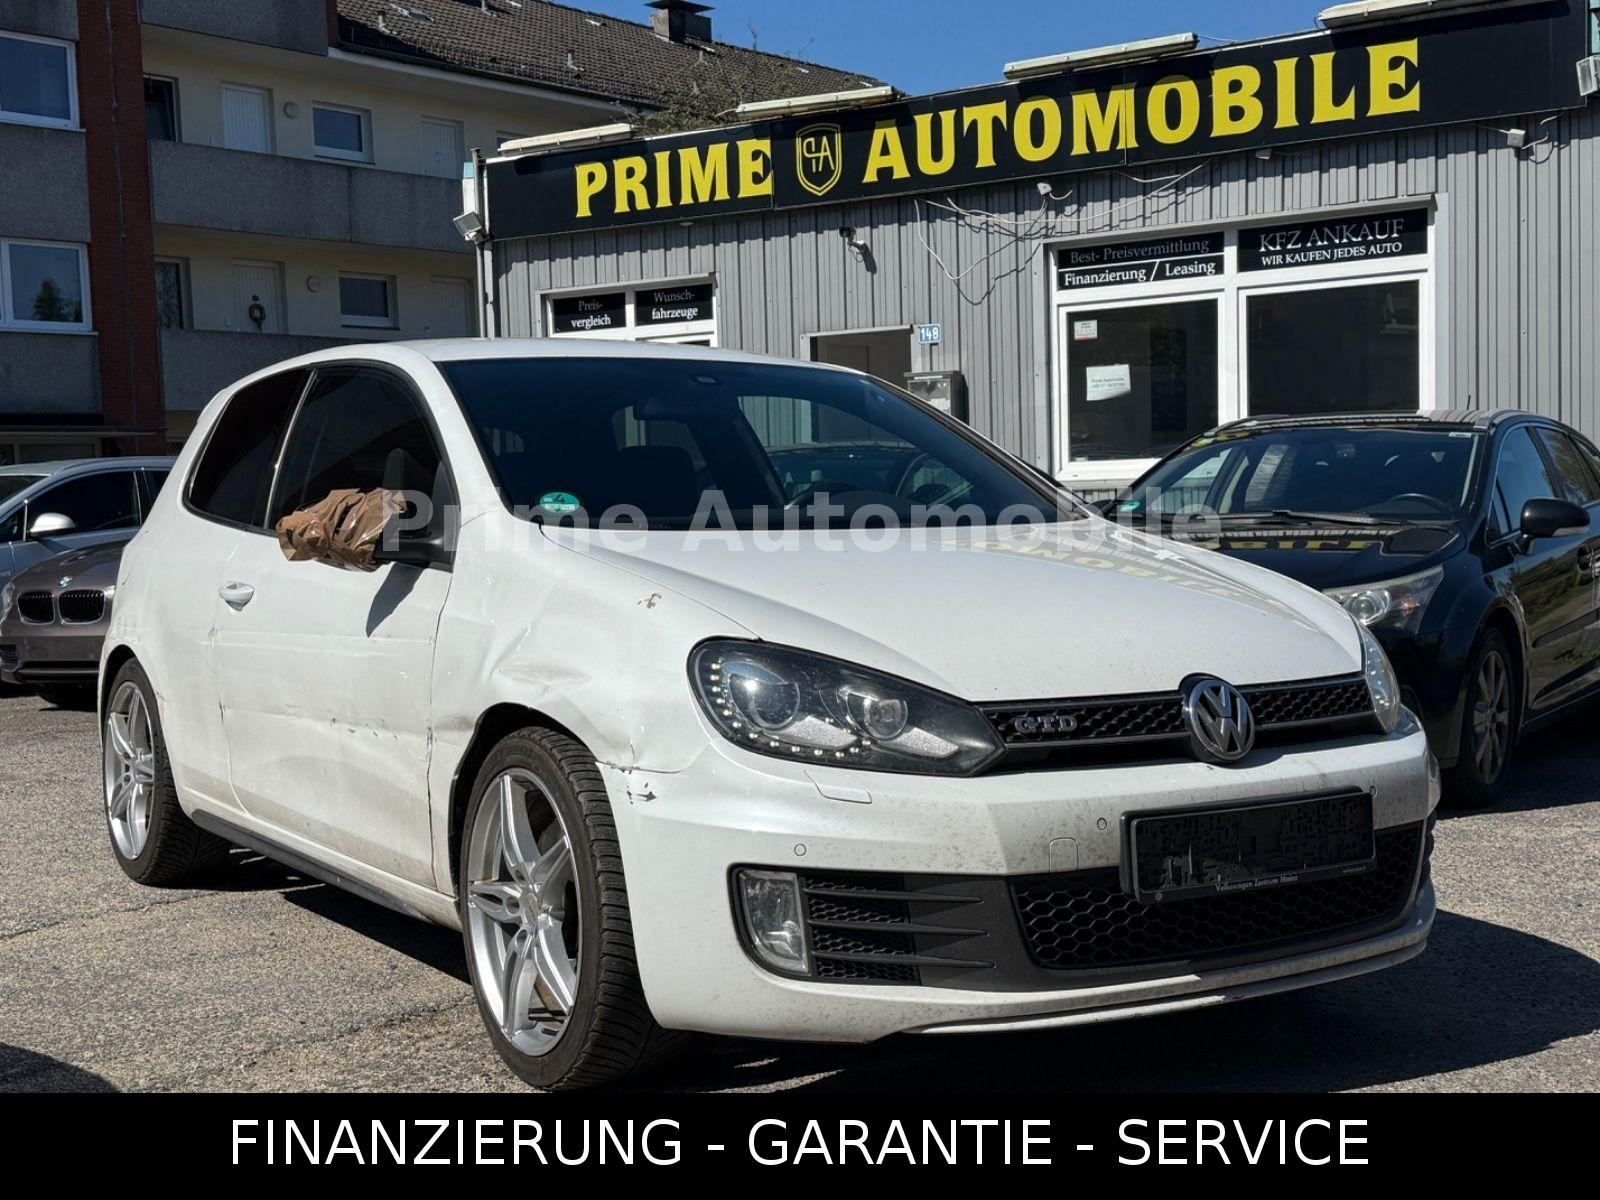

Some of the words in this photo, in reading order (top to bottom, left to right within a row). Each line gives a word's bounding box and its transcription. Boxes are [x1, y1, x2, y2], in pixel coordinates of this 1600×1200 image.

[574, 138, 773, 218] PRIME
[863, 38, 1421, 184] AUTOMOBILE
[1259, 230, 1302, 252] KFZ
[1306, 218, 1405, 248] ANKAUF
[1070, 251, 1100, 264] Best-
[1103, 239, 1210, 261] Preisvermittlung
[1261, 255, 1284, 266] WIR
[1285, 250, 1331, 263] KAUFEN
[1332, 247, 1367, 261] JEDES
[1368, 241, 1403, 255] AUTO
[1064, 268, 1147, 287] Finanzierung
[1165, 260, 1216, 277] Leasing
[653, 289, 696, 302] Wunsch-
[578, 300, 603, 312] Preis-
[651, 306, 698, 321] fahrzeuge
[570, 314, 611, 329] vergleich
[920, 326, 939, 340] 148
[1014, 714, 1078, 734] GTD
